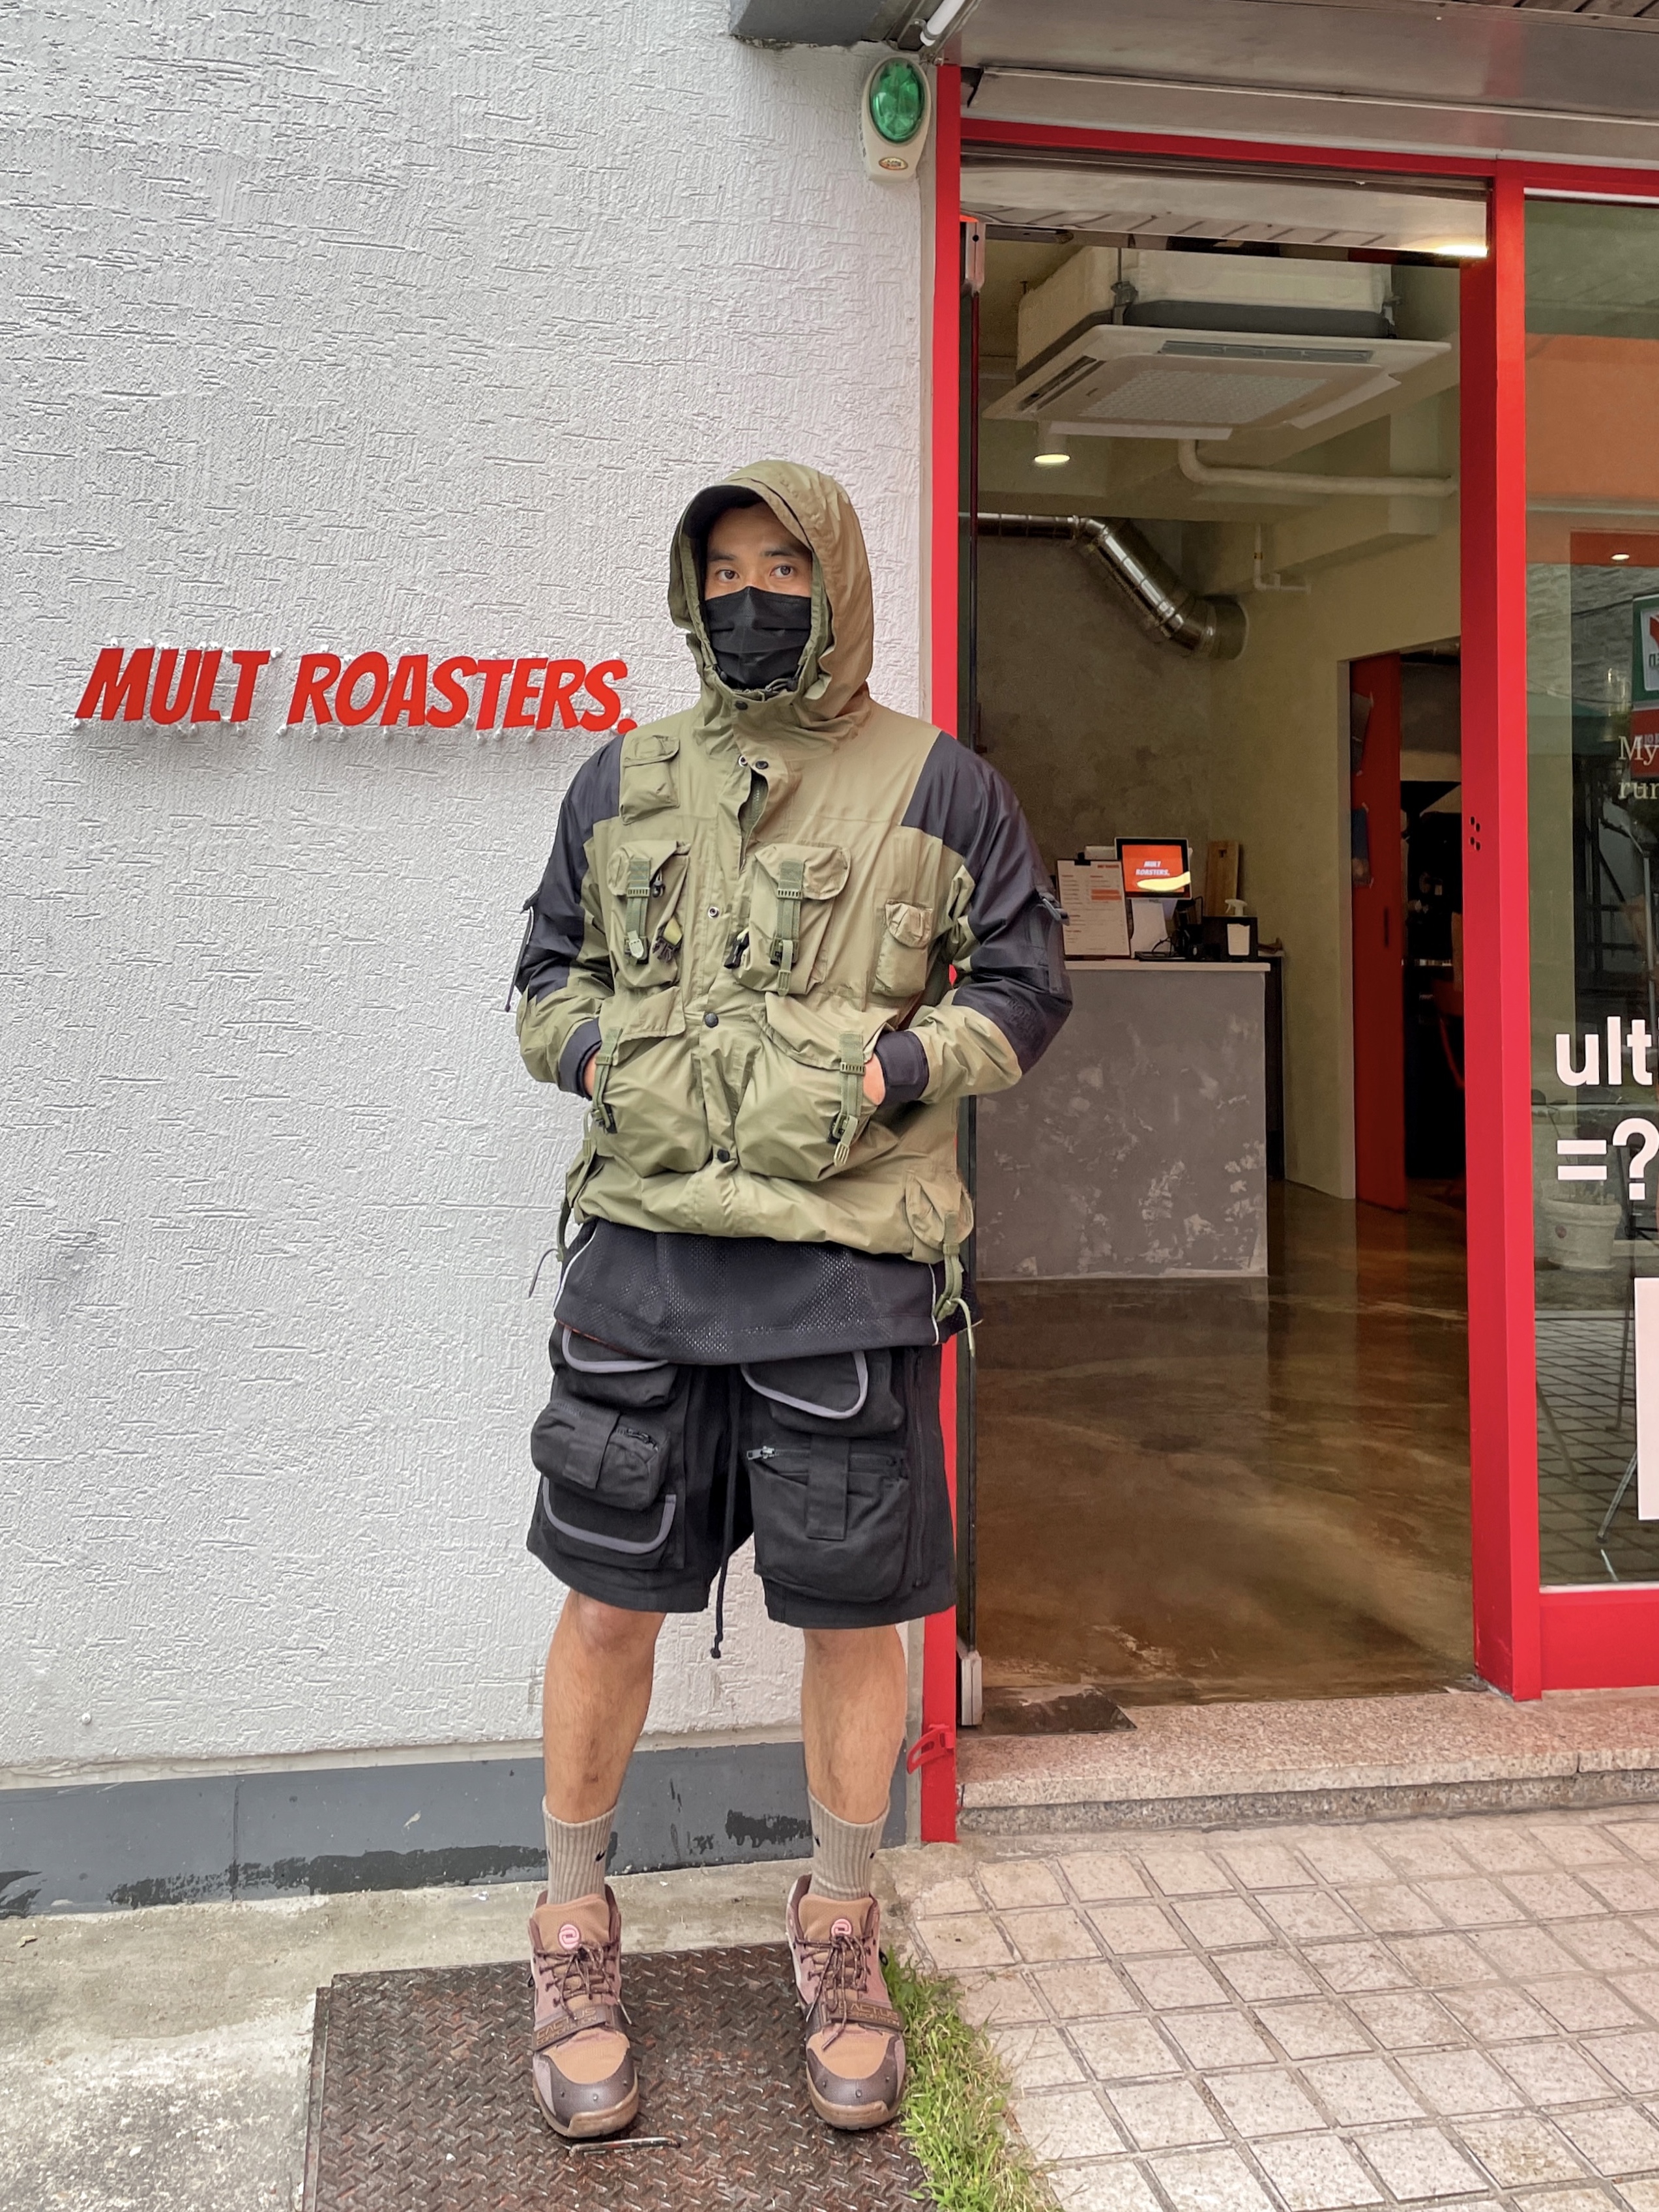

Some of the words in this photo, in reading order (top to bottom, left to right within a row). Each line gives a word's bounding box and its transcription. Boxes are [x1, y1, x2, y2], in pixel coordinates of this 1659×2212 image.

[76, 649, 269, 724] MULT
[288, 652, 637, 734] ROASTERS.
[1555, 1016, 1659, 1086] ult
